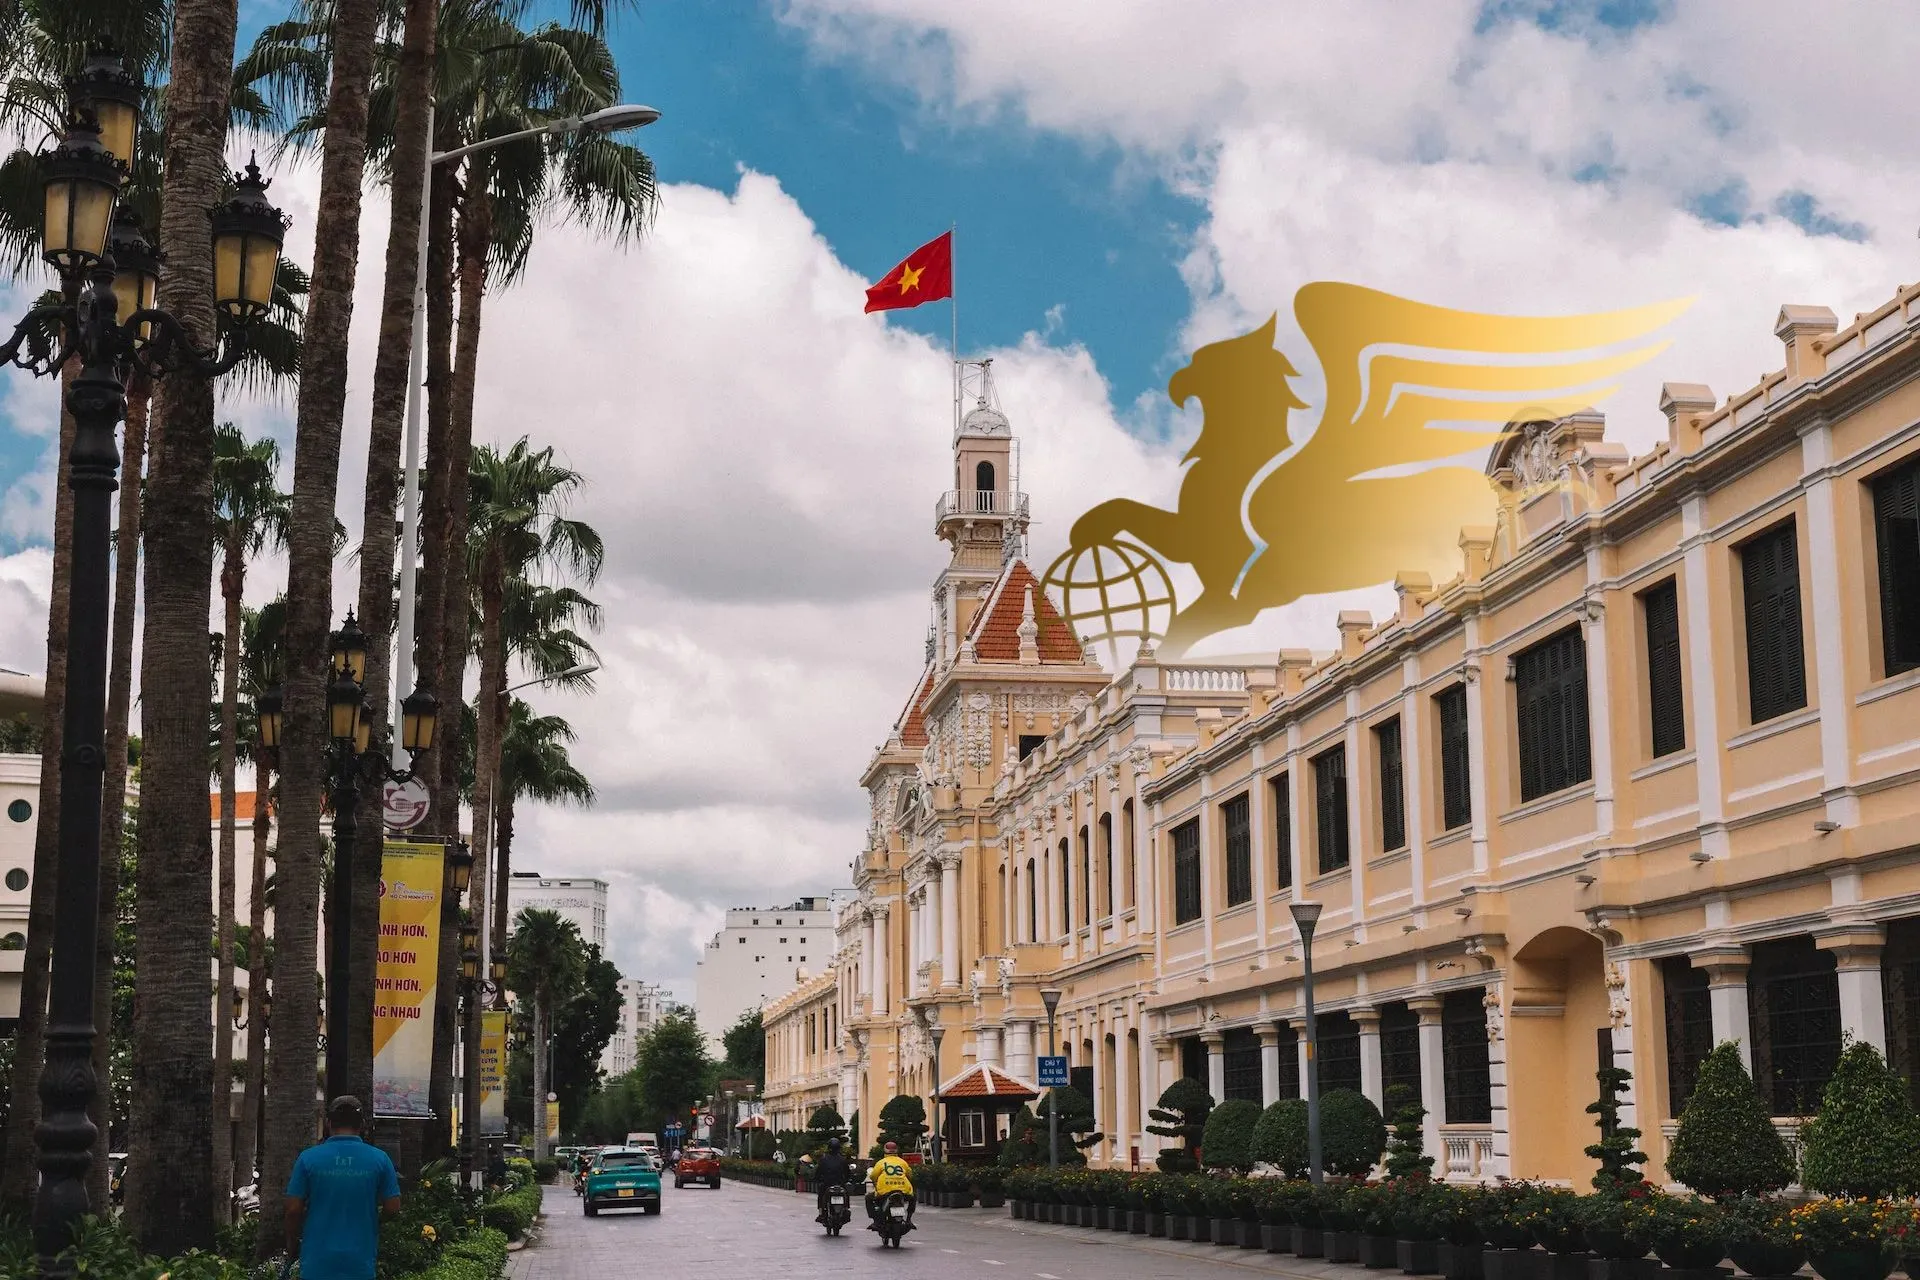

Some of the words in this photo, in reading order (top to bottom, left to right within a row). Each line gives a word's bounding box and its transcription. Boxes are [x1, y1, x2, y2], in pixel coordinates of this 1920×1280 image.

[402, 924, 428, 938] HƠN,
[393, 951, 416, 964] HƠN
[390, 1006, 421, 1018] NHAU
[884, 1162, 904, 1176] be
